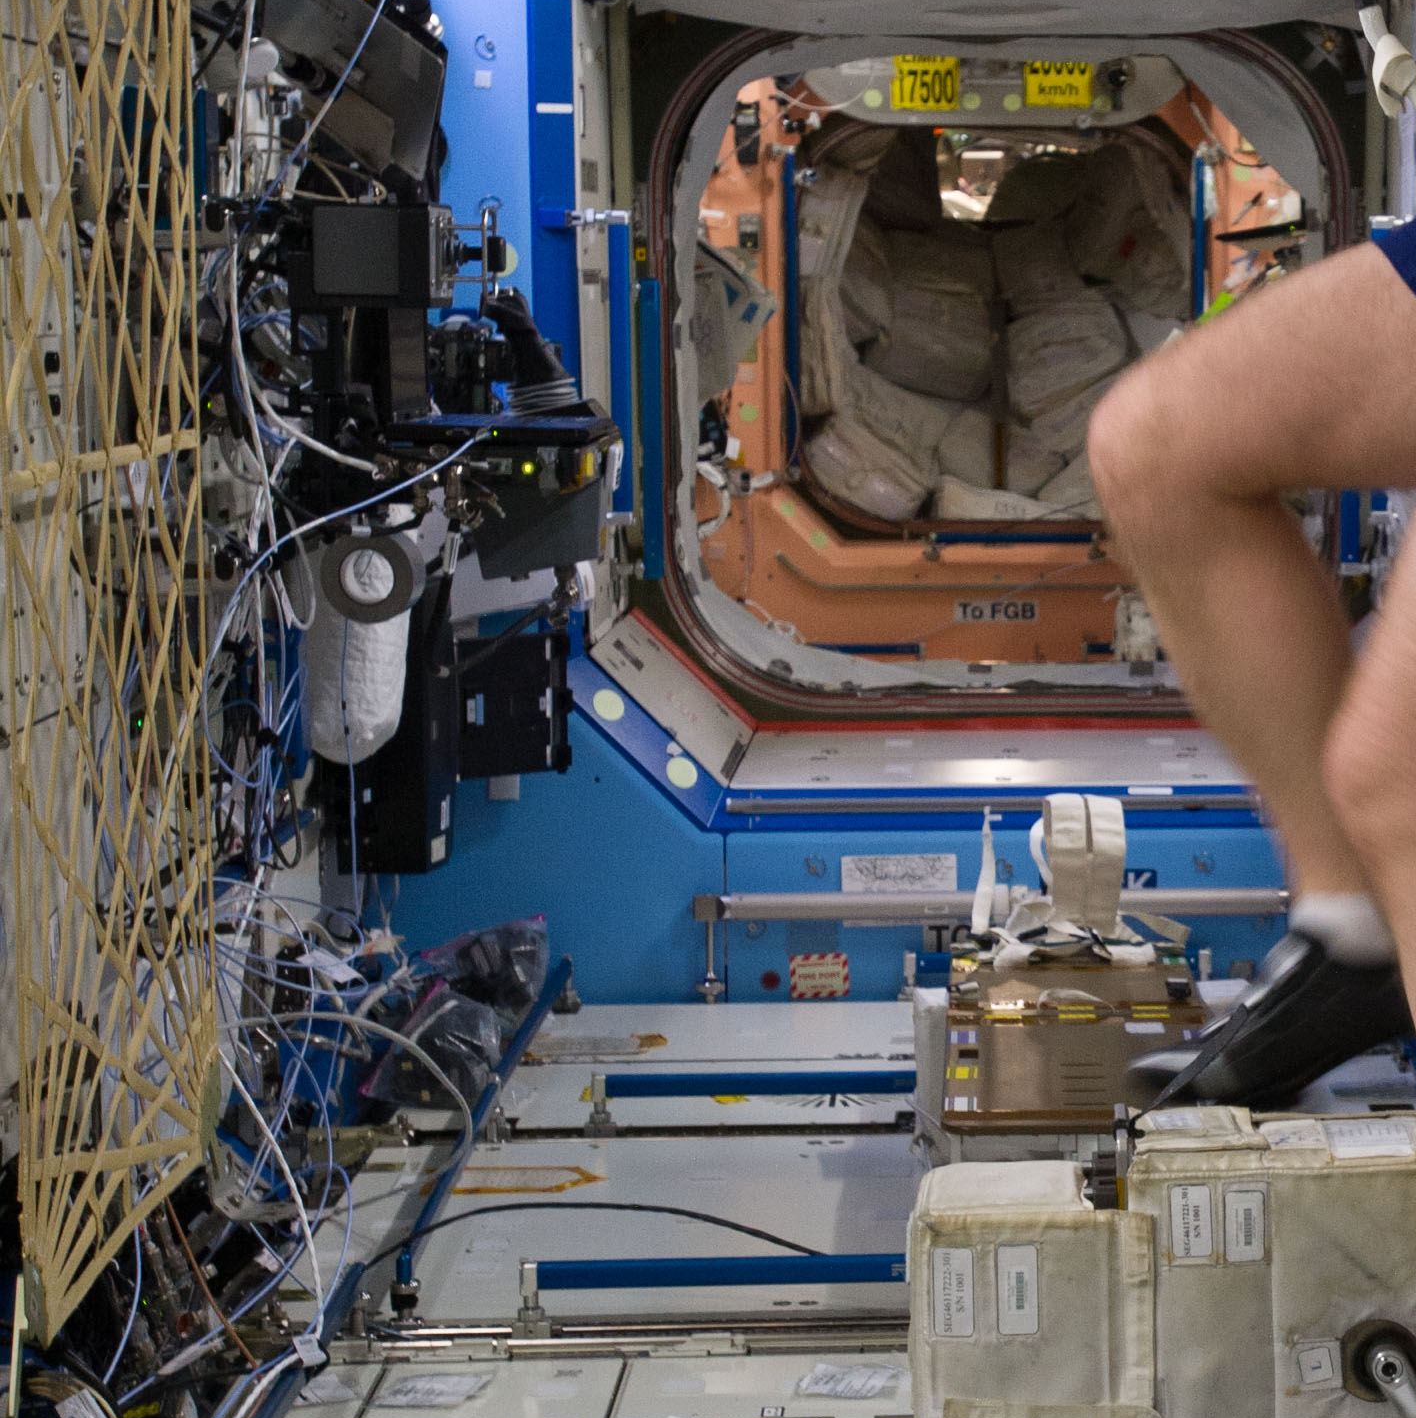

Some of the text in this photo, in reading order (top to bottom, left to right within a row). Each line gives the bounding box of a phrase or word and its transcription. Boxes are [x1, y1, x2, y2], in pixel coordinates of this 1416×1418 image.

[899, 69, 954, 104] 17500
[1037, 83, 1079, 96] km/h
[959, 602, 1036, 620] To FGB
